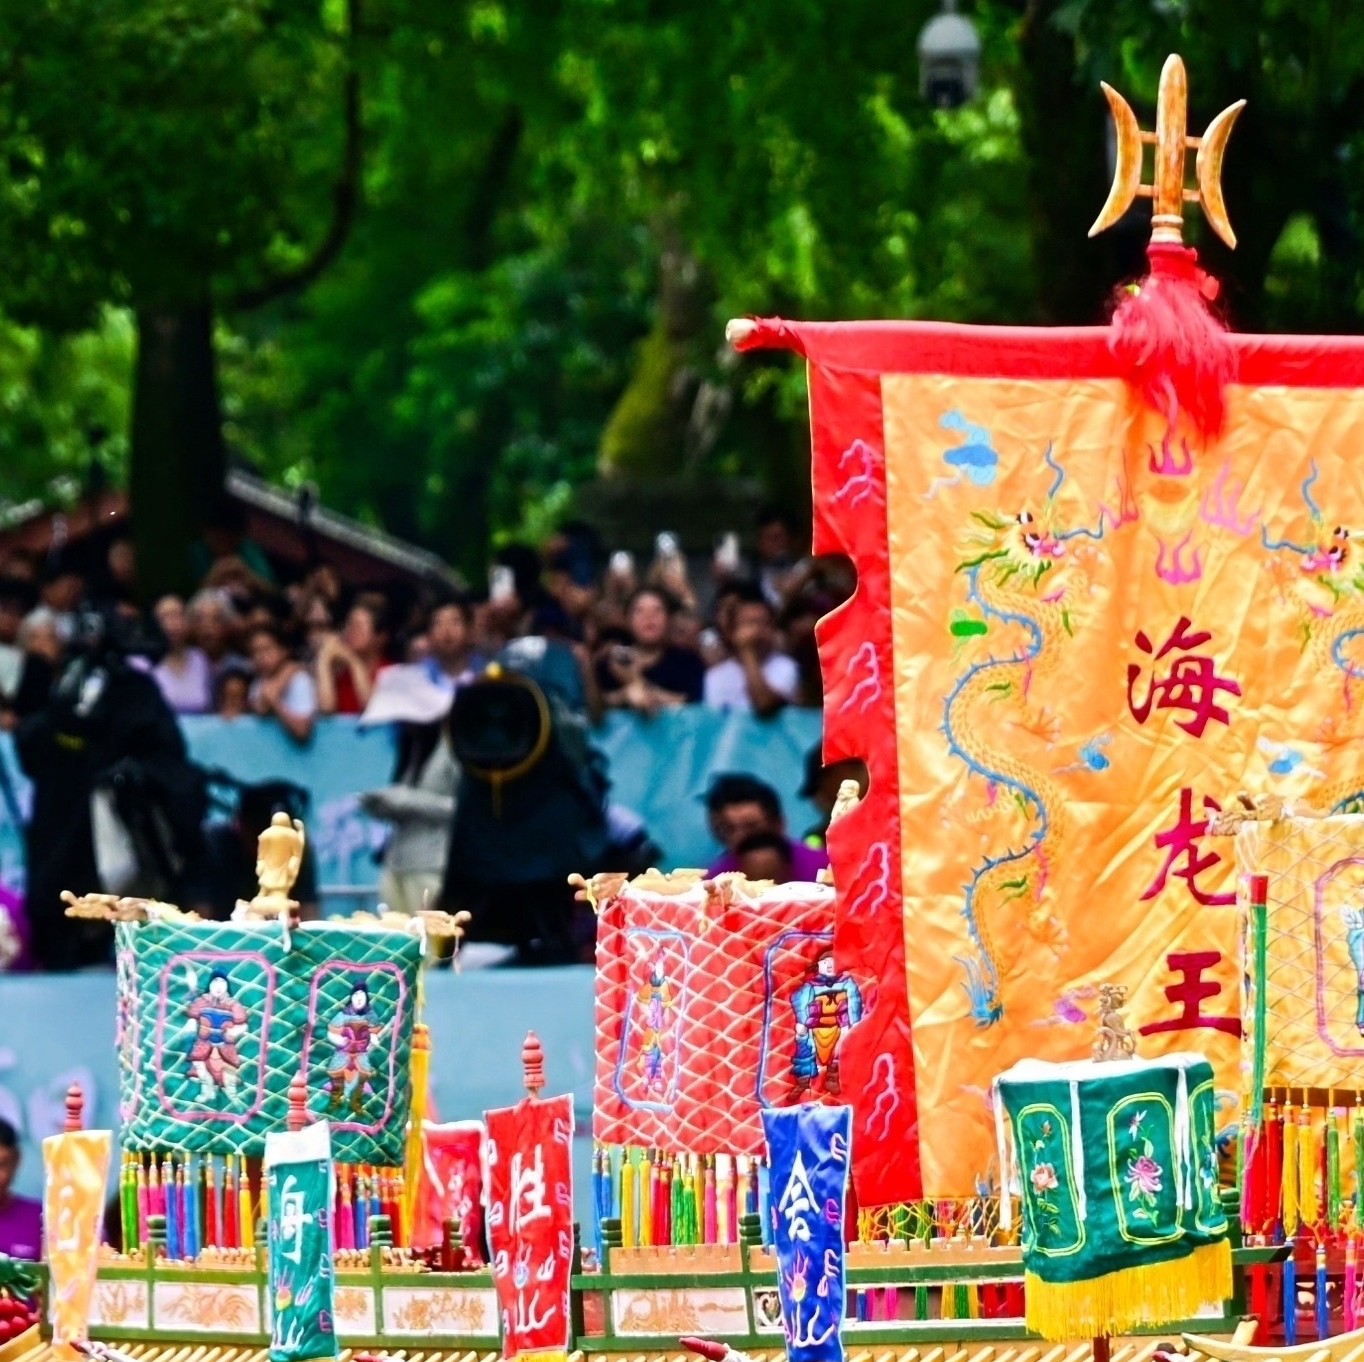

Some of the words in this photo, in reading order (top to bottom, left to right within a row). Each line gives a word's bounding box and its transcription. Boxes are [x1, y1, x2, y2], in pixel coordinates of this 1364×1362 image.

[1127, 615, 1243, 1039] 海龙王
[280, 1174, 313, 1265] 舟
[508, 1143, 552, 1237] 胜
[778, 1149, 821, 1243] 会
